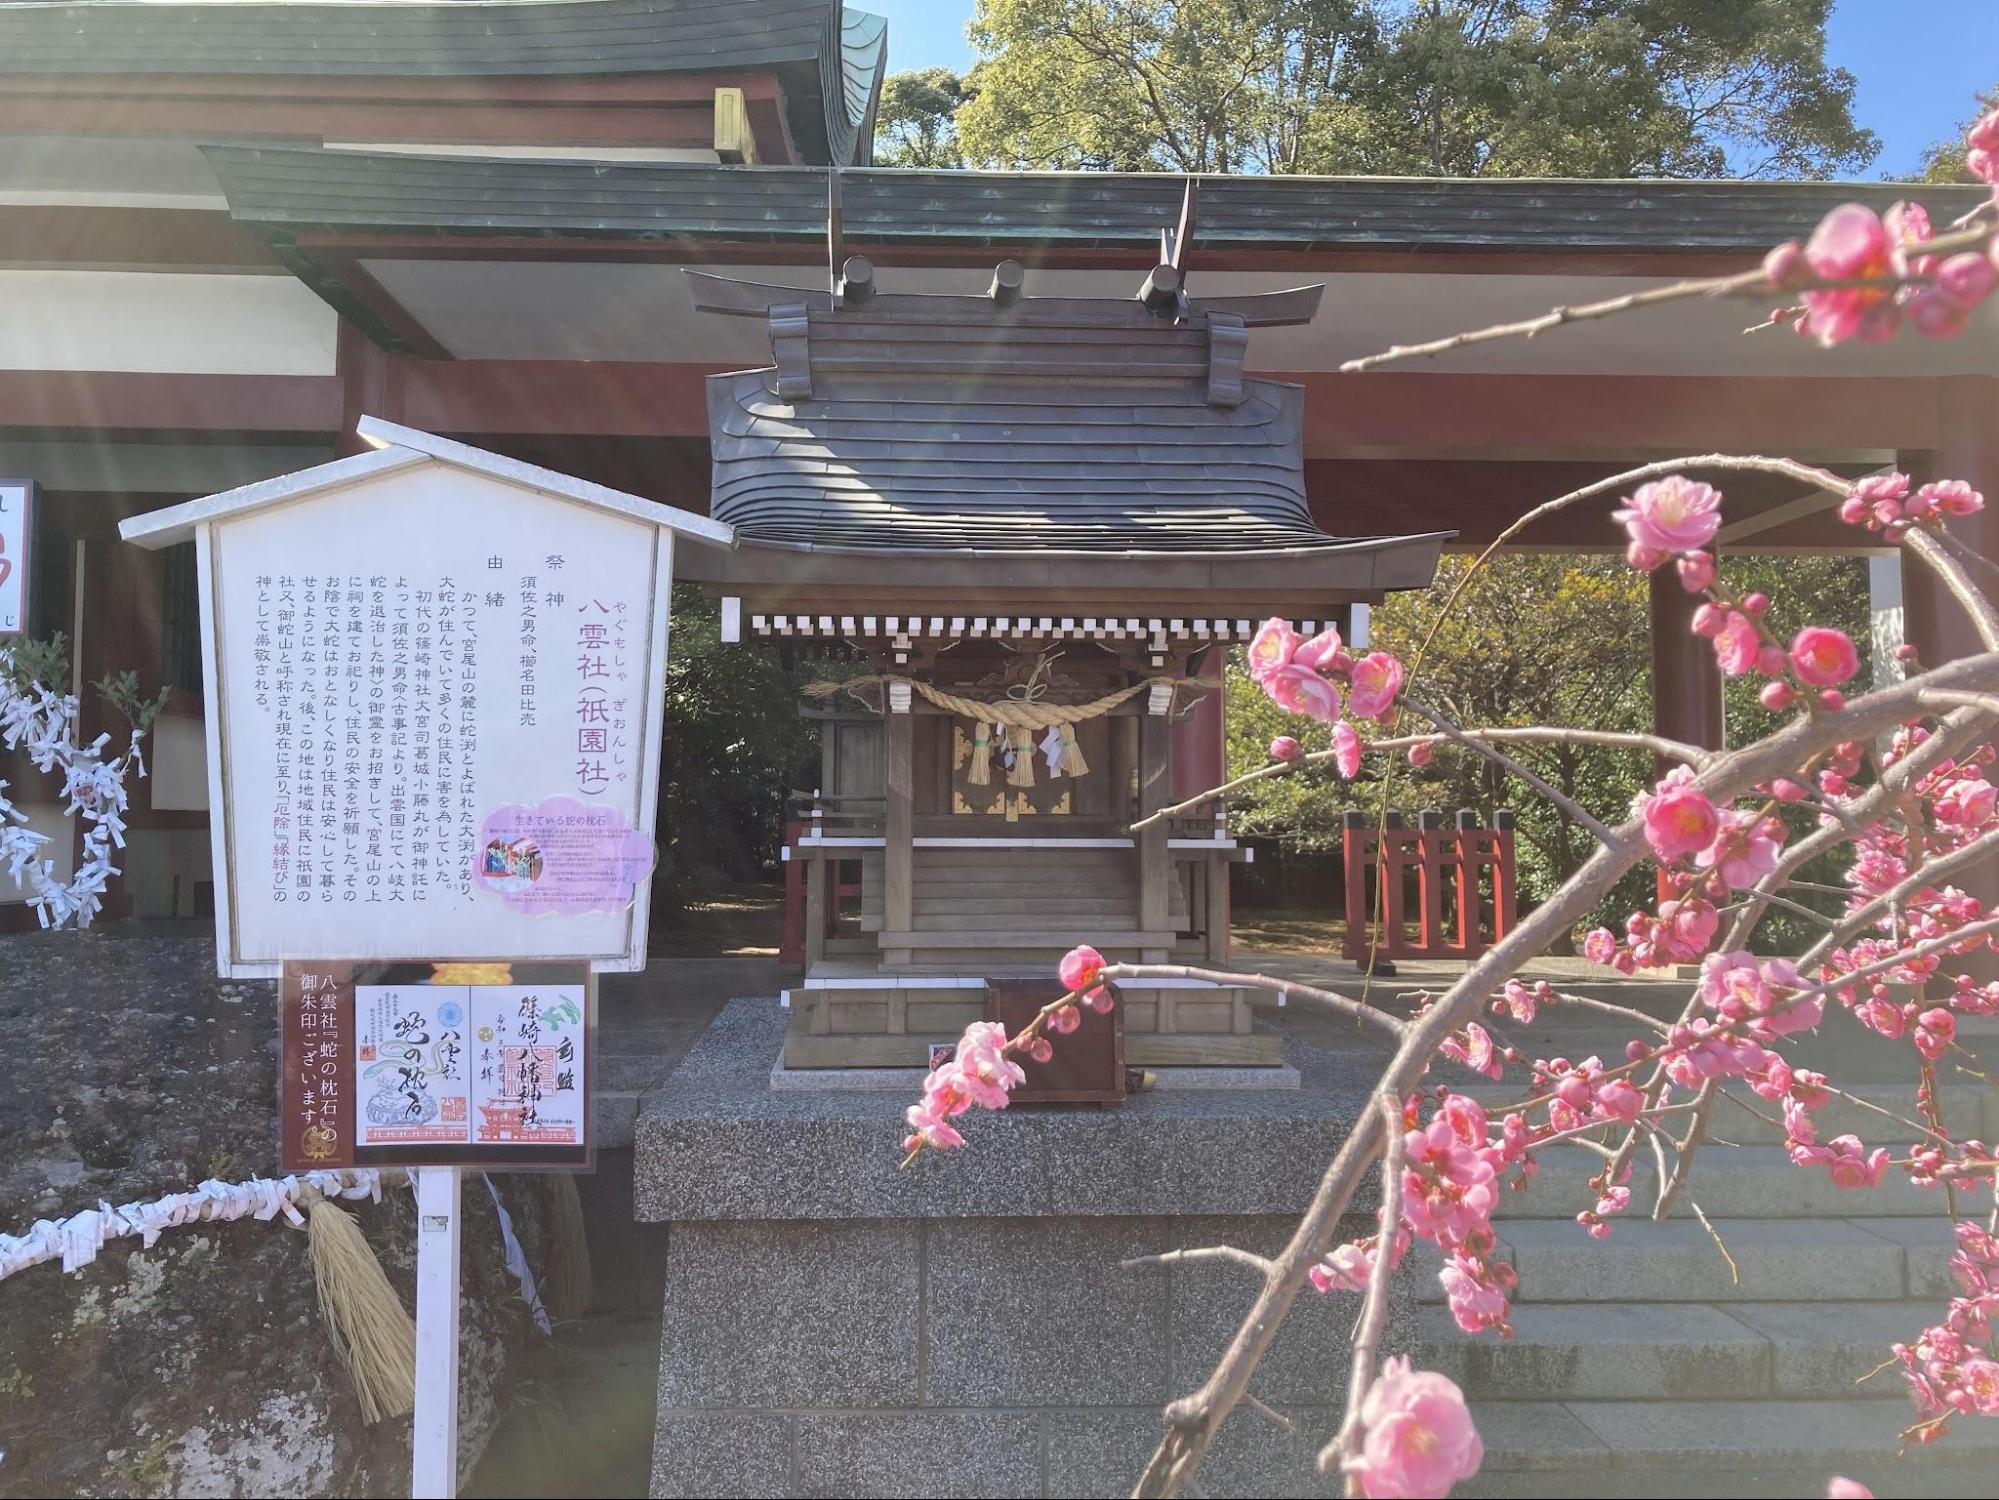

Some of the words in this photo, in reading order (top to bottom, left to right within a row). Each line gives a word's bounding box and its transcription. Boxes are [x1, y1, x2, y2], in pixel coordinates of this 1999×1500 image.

[484, 554, 506, 608] 由緒
[545, 554, 565, 608] 祭神
[254, 575, 272, 713] 神として崇敬される。
[612, 697, 628, 782] ぎおんしゃ
[300, 973, 318, 1133] 御朱印ございます。
[319, 974, 338, 1142] 八雲社『蛇の枕石』の
